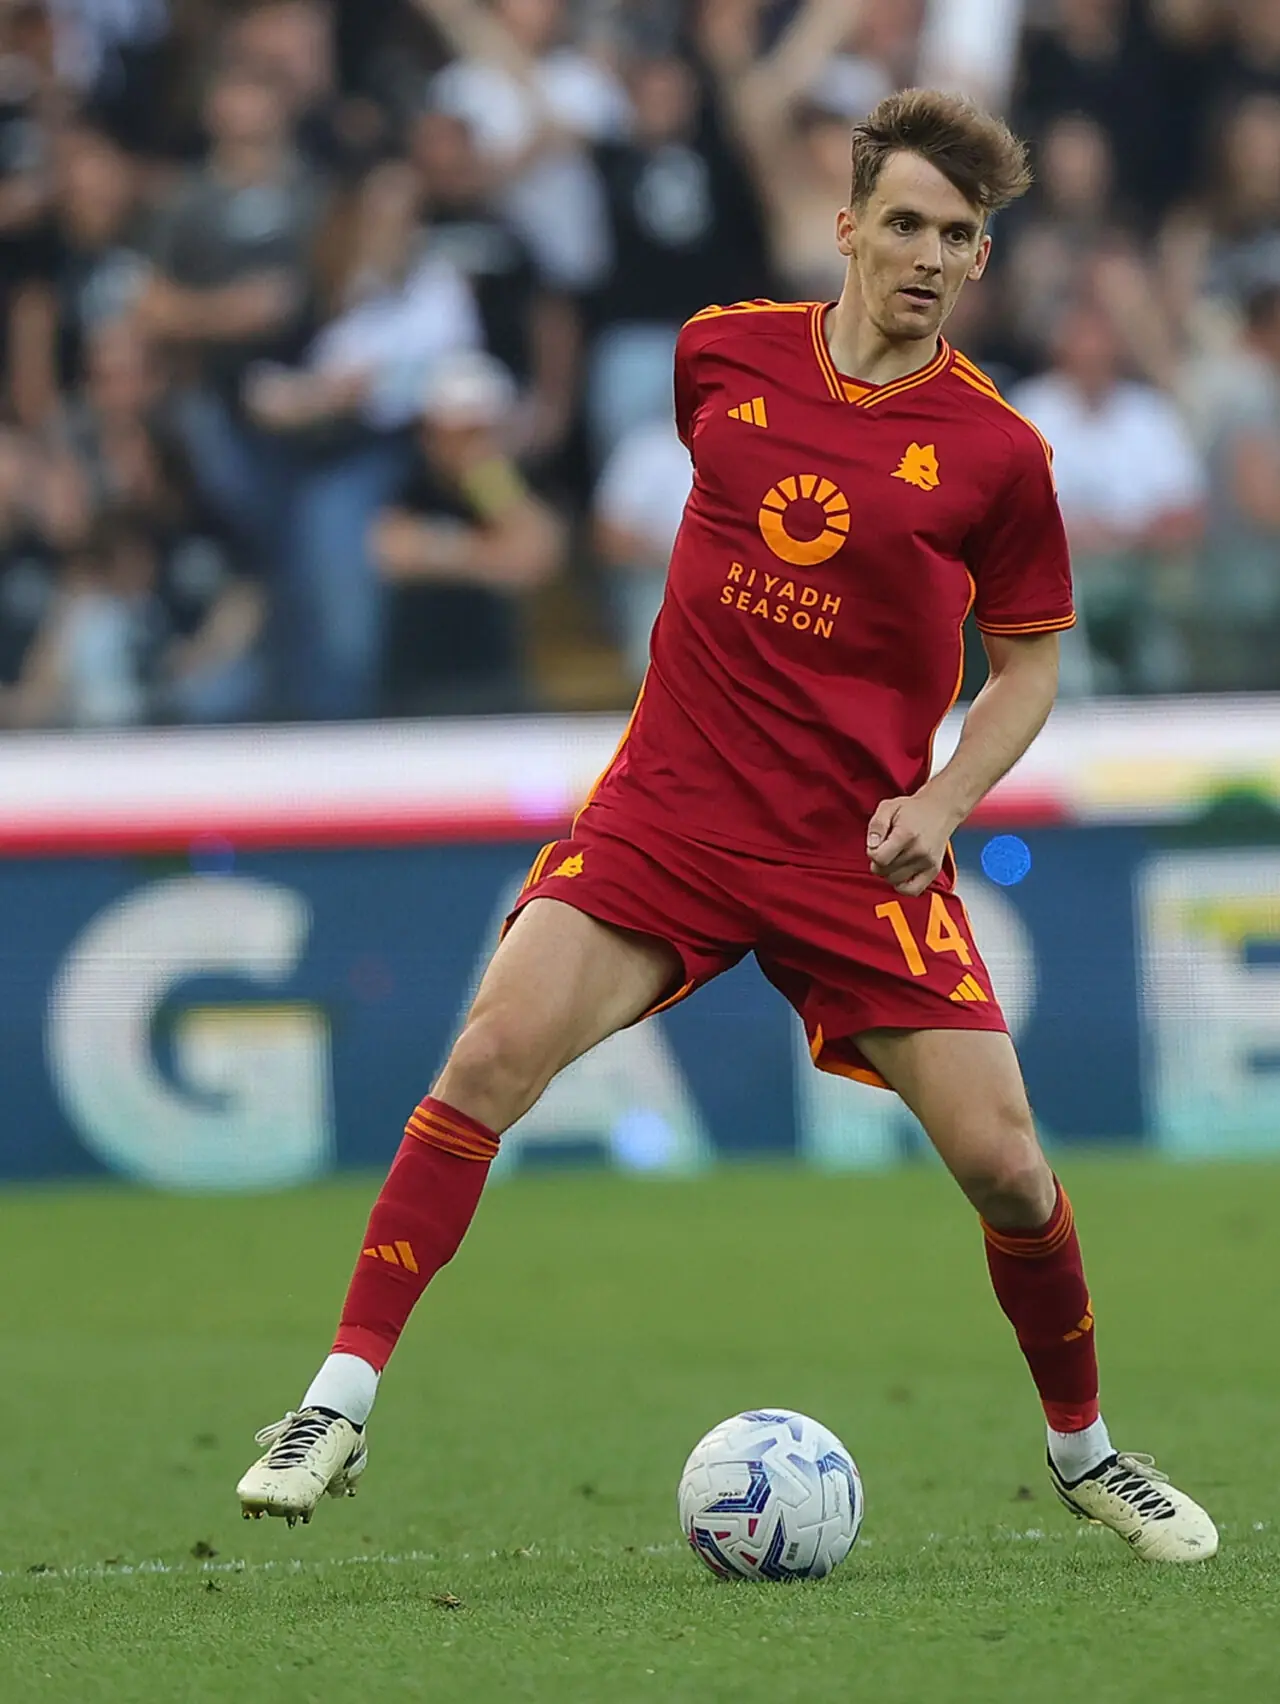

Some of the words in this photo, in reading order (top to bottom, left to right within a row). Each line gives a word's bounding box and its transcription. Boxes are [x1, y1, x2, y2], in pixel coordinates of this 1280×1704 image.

[720, 586, 834, 638] SEASON
[727, 562, 842, 615] RIYADH
[875, 892, 973, 976] 14
